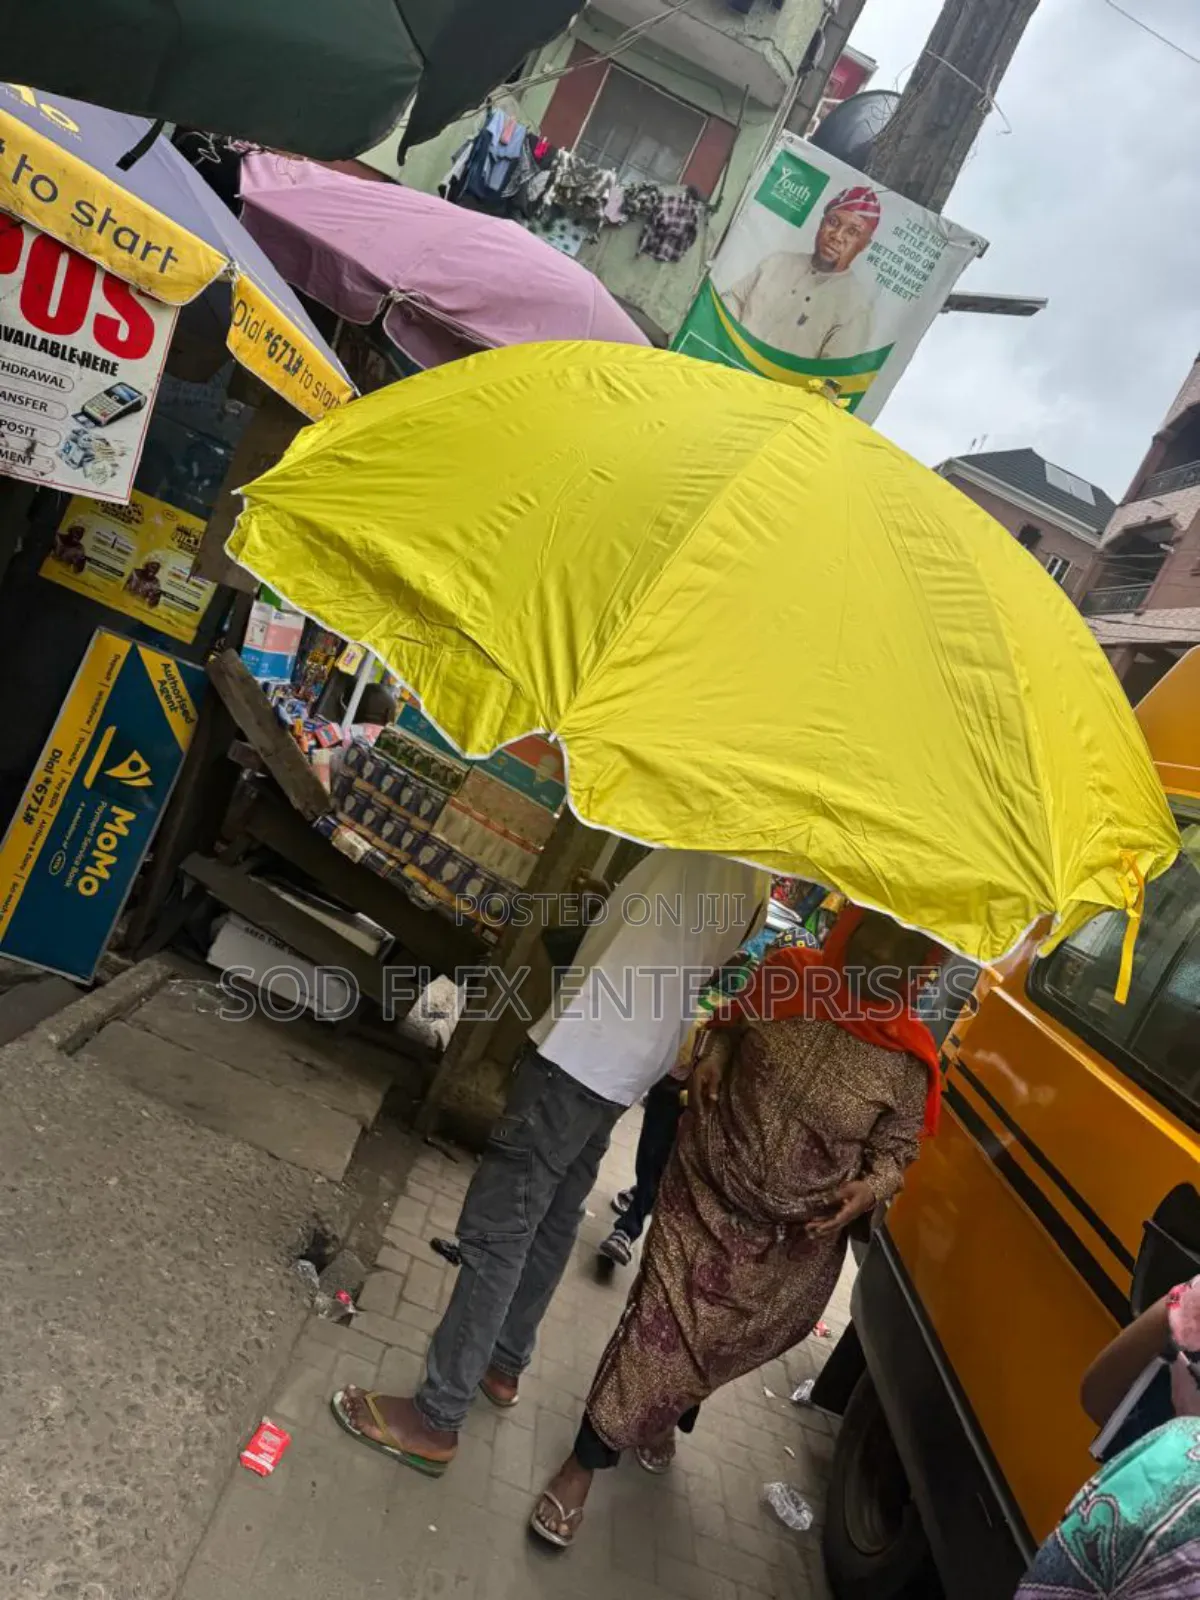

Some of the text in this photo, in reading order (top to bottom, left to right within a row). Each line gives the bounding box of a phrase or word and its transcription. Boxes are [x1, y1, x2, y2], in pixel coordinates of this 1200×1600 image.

[773, 166, 812, 202] Youth
[12, 154, 179, 273] to start
[892, 226, 942, 261] SETTLE FOR
[897, 243, 936, 273] GOOD OR
[929, 234, 949, 250] NOT
[866, 253, 924, 293] WE CAN HAVE
[870, 241, 930, 282] BETTER WHEN
[876, 272, 894, 289] THE
[0, 323, 119, 377] VAILABLE HERE
[234, 299, 266, 344] Dial
[299, 364, 314, 388] to
[0, 360, 66, 389] HDRAWAL
[157, 679, 179, 713] Agent
[161, 663, 195, 724] Authorised
[43, 748, 63, 775] Dial
[78, 805, 137, 896] MoMo
